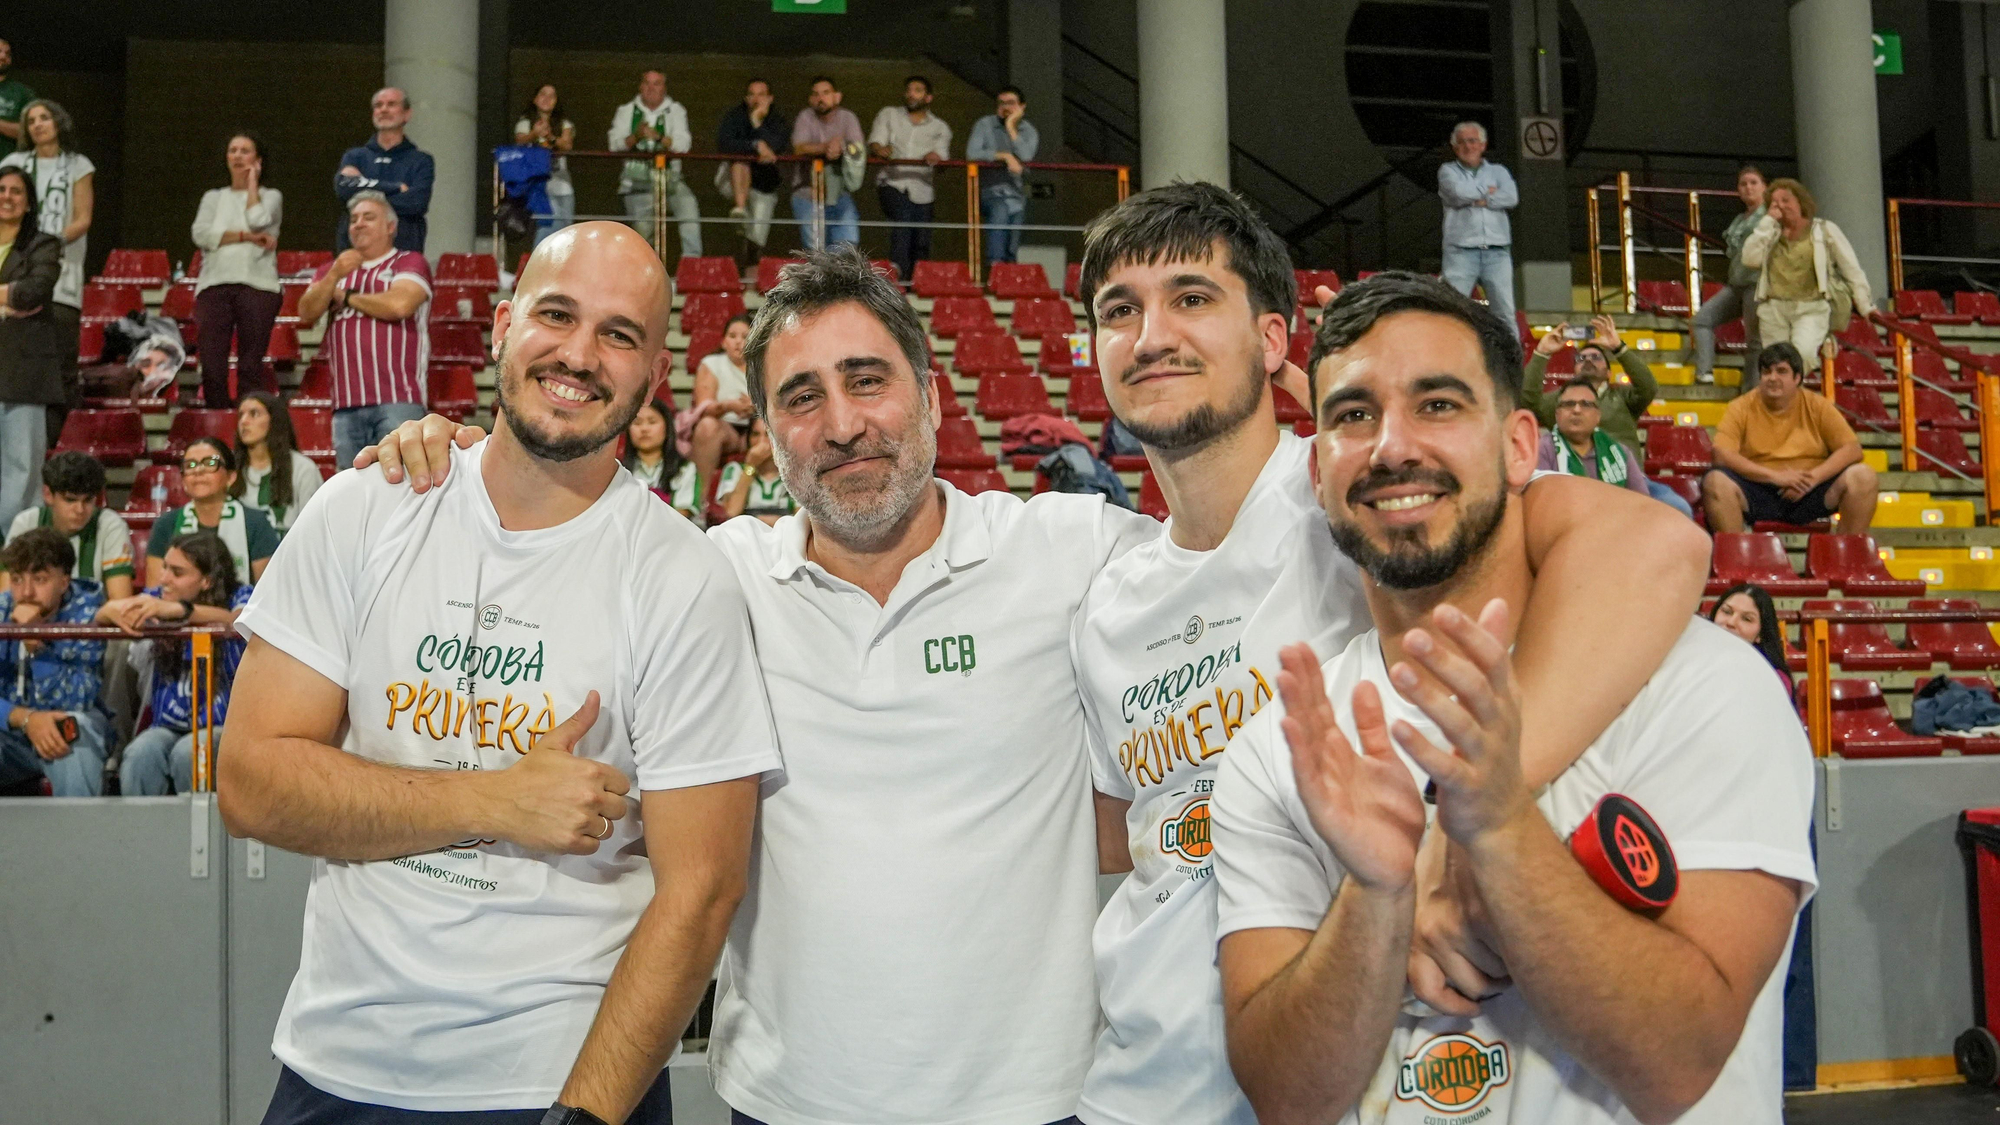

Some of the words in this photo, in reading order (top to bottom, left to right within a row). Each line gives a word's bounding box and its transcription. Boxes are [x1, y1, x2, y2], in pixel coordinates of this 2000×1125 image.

[446, 600, 474, 609] ASCENSO
[484, 611, 498, 623] CCB
[924, 634, 976, 675] CCB
[1153, 706, 1168, 726] ES
[1170, 697, 1187, 714] DE
[1166, 819, 1212, 849] CORD
[388, 856, 498, 892] GANAMOSJUNTOS
[1175, 864, 1192, 875] COTO
[1401, 1049, 1504, 1094] CORDOBA
